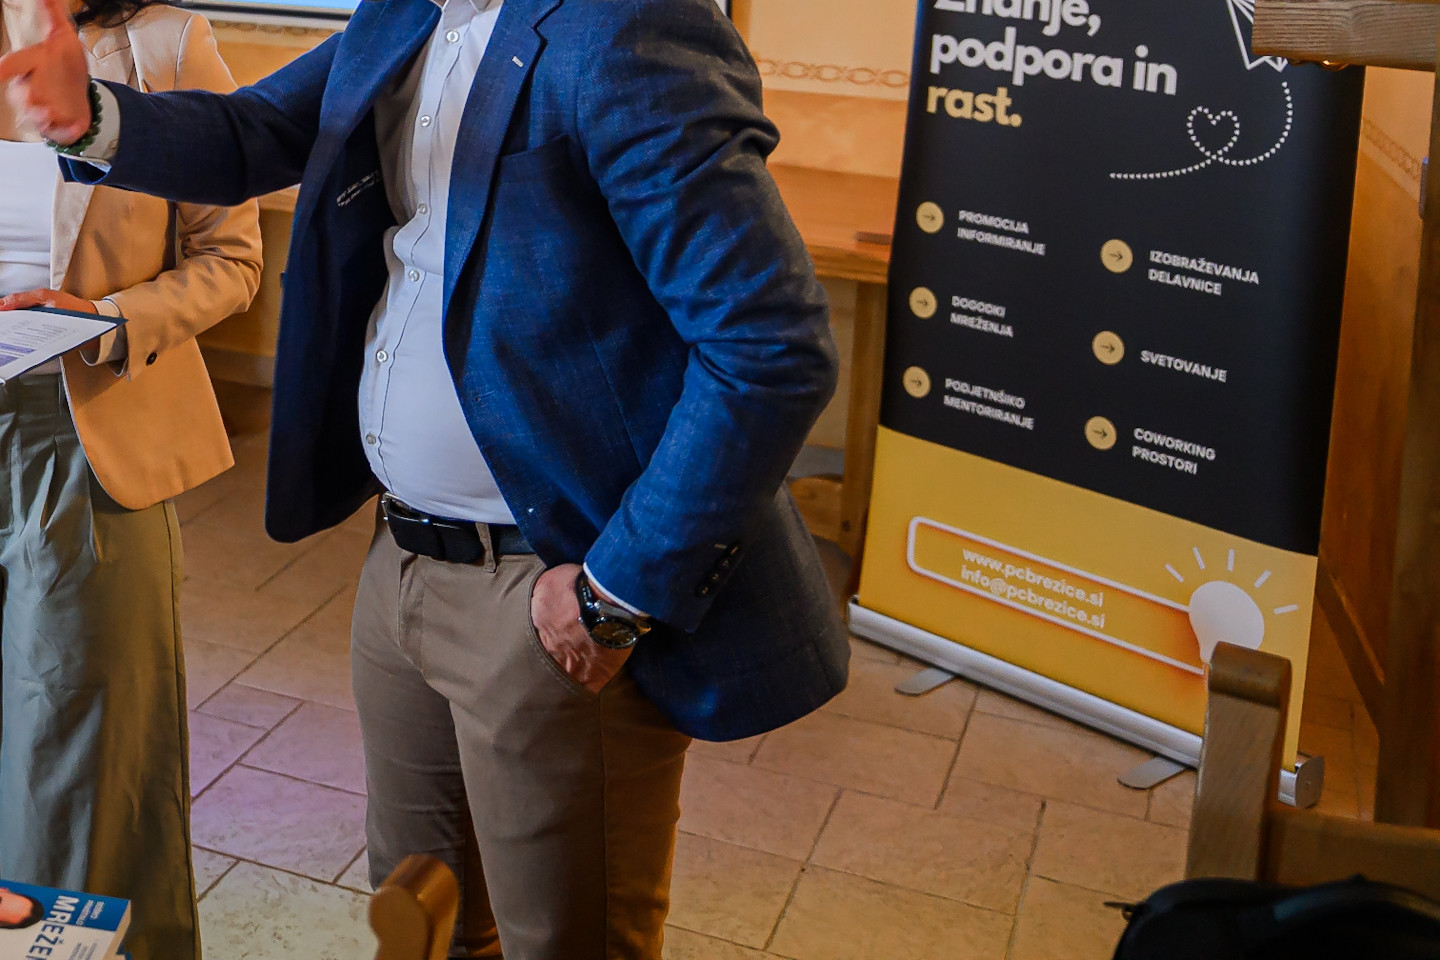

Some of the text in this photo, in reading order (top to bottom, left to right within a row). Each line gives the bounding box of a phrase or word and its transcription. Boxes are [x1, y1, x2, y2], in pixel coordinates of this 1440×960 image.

[930, 26, 1177, 95] podpora in
[926, 85, 1022, 127] rast.
[958, 209, 1029, 234] PROMOCIJA
[957, 227, 1046, 256] INFORMIRANJE
[1148, 268, 1222, 296] DELAVNICE
[1149, 250, 1259, 285] IZOBRAŽEVANJA
[951, 295, 1006, 318] DOGODKI
[950, 312, 1013, 338] MREŽENJA
[1140, 350, 1227, 383] SVETOVANJE
[943, 395, 1035, 430] MENTORIRANJE
[1132, 445, 1197, 475] PROSTORI
[1134, 428, 1216, 460] COWORKING
[963, 549, 1104, 607] www.pcbrezice.si
[961, 565, 1105, 629] info@pcbrezice.si
